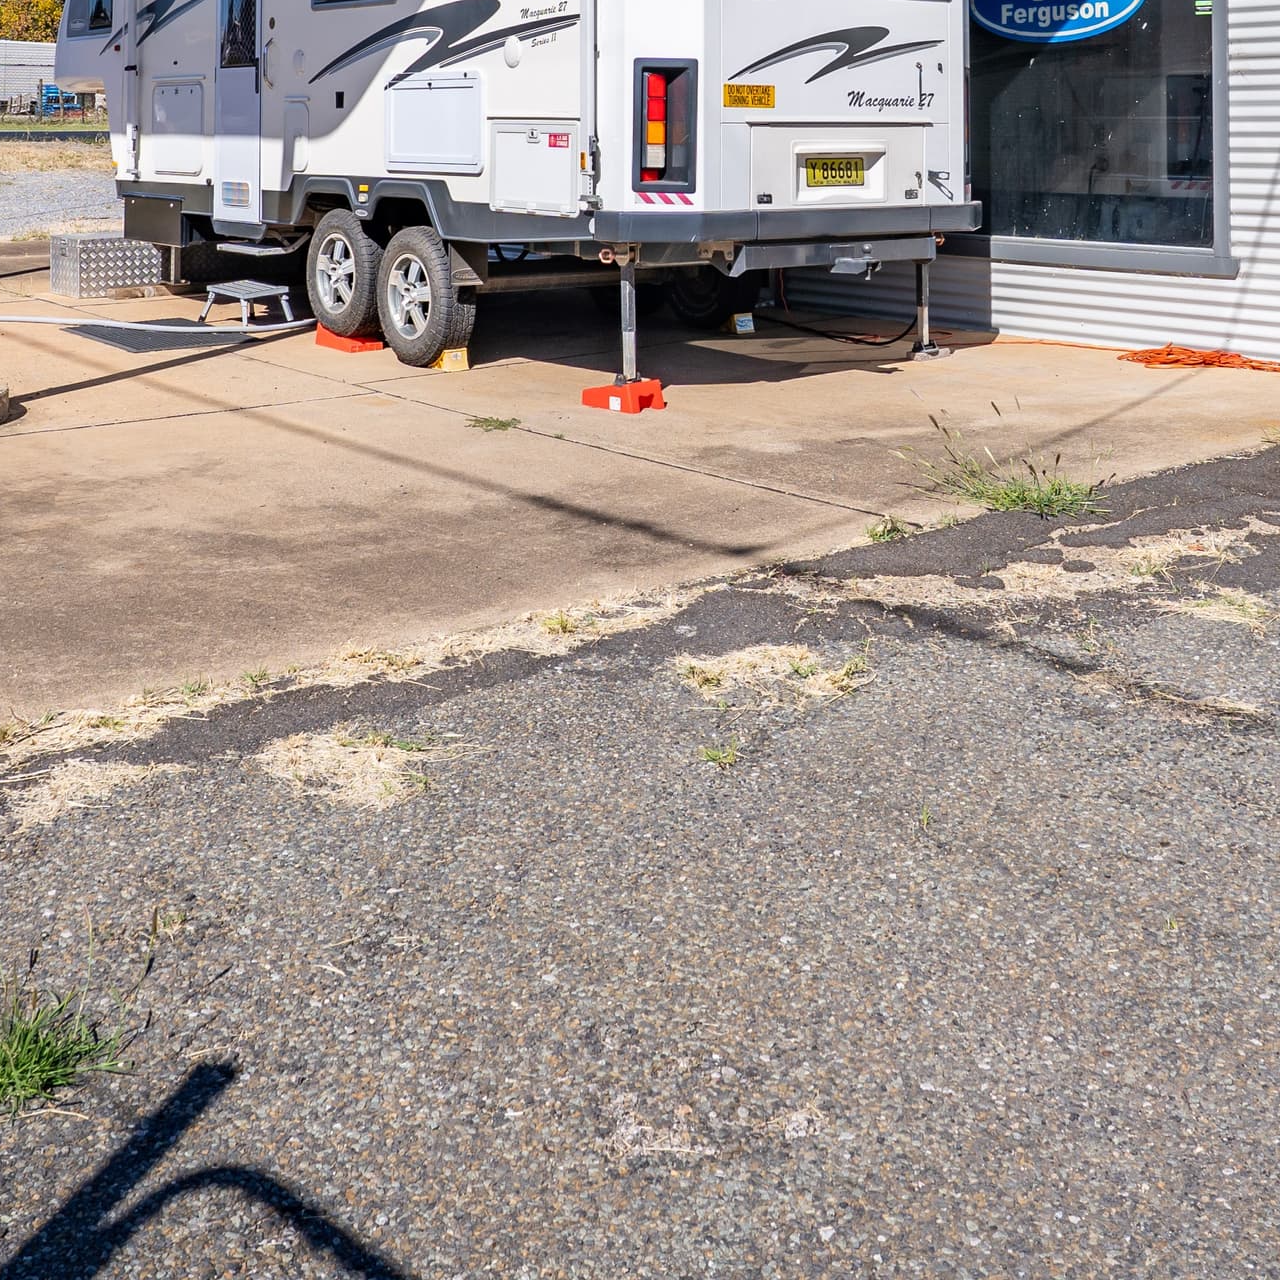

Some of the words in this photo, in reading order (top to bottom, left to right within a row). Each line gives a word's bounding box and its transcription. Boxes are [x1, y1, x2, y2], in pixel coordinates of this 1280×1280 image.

[558, 0, 568, 12] 27
[1001, 0, 1109, 27] Ferguson
[728, 84, 736, 95] DO
[736, 85, 746, 95] NOT
[746, 85, 771, 95] OVERTAKE
[728, 95, 750, 105] TURNING
[751, 95, 771, 105] VEHICLE
[847, 90, 915, 112] Macquarie
[918, 93, 935, 107] 27
[822, 160, 859, 180] 86681
